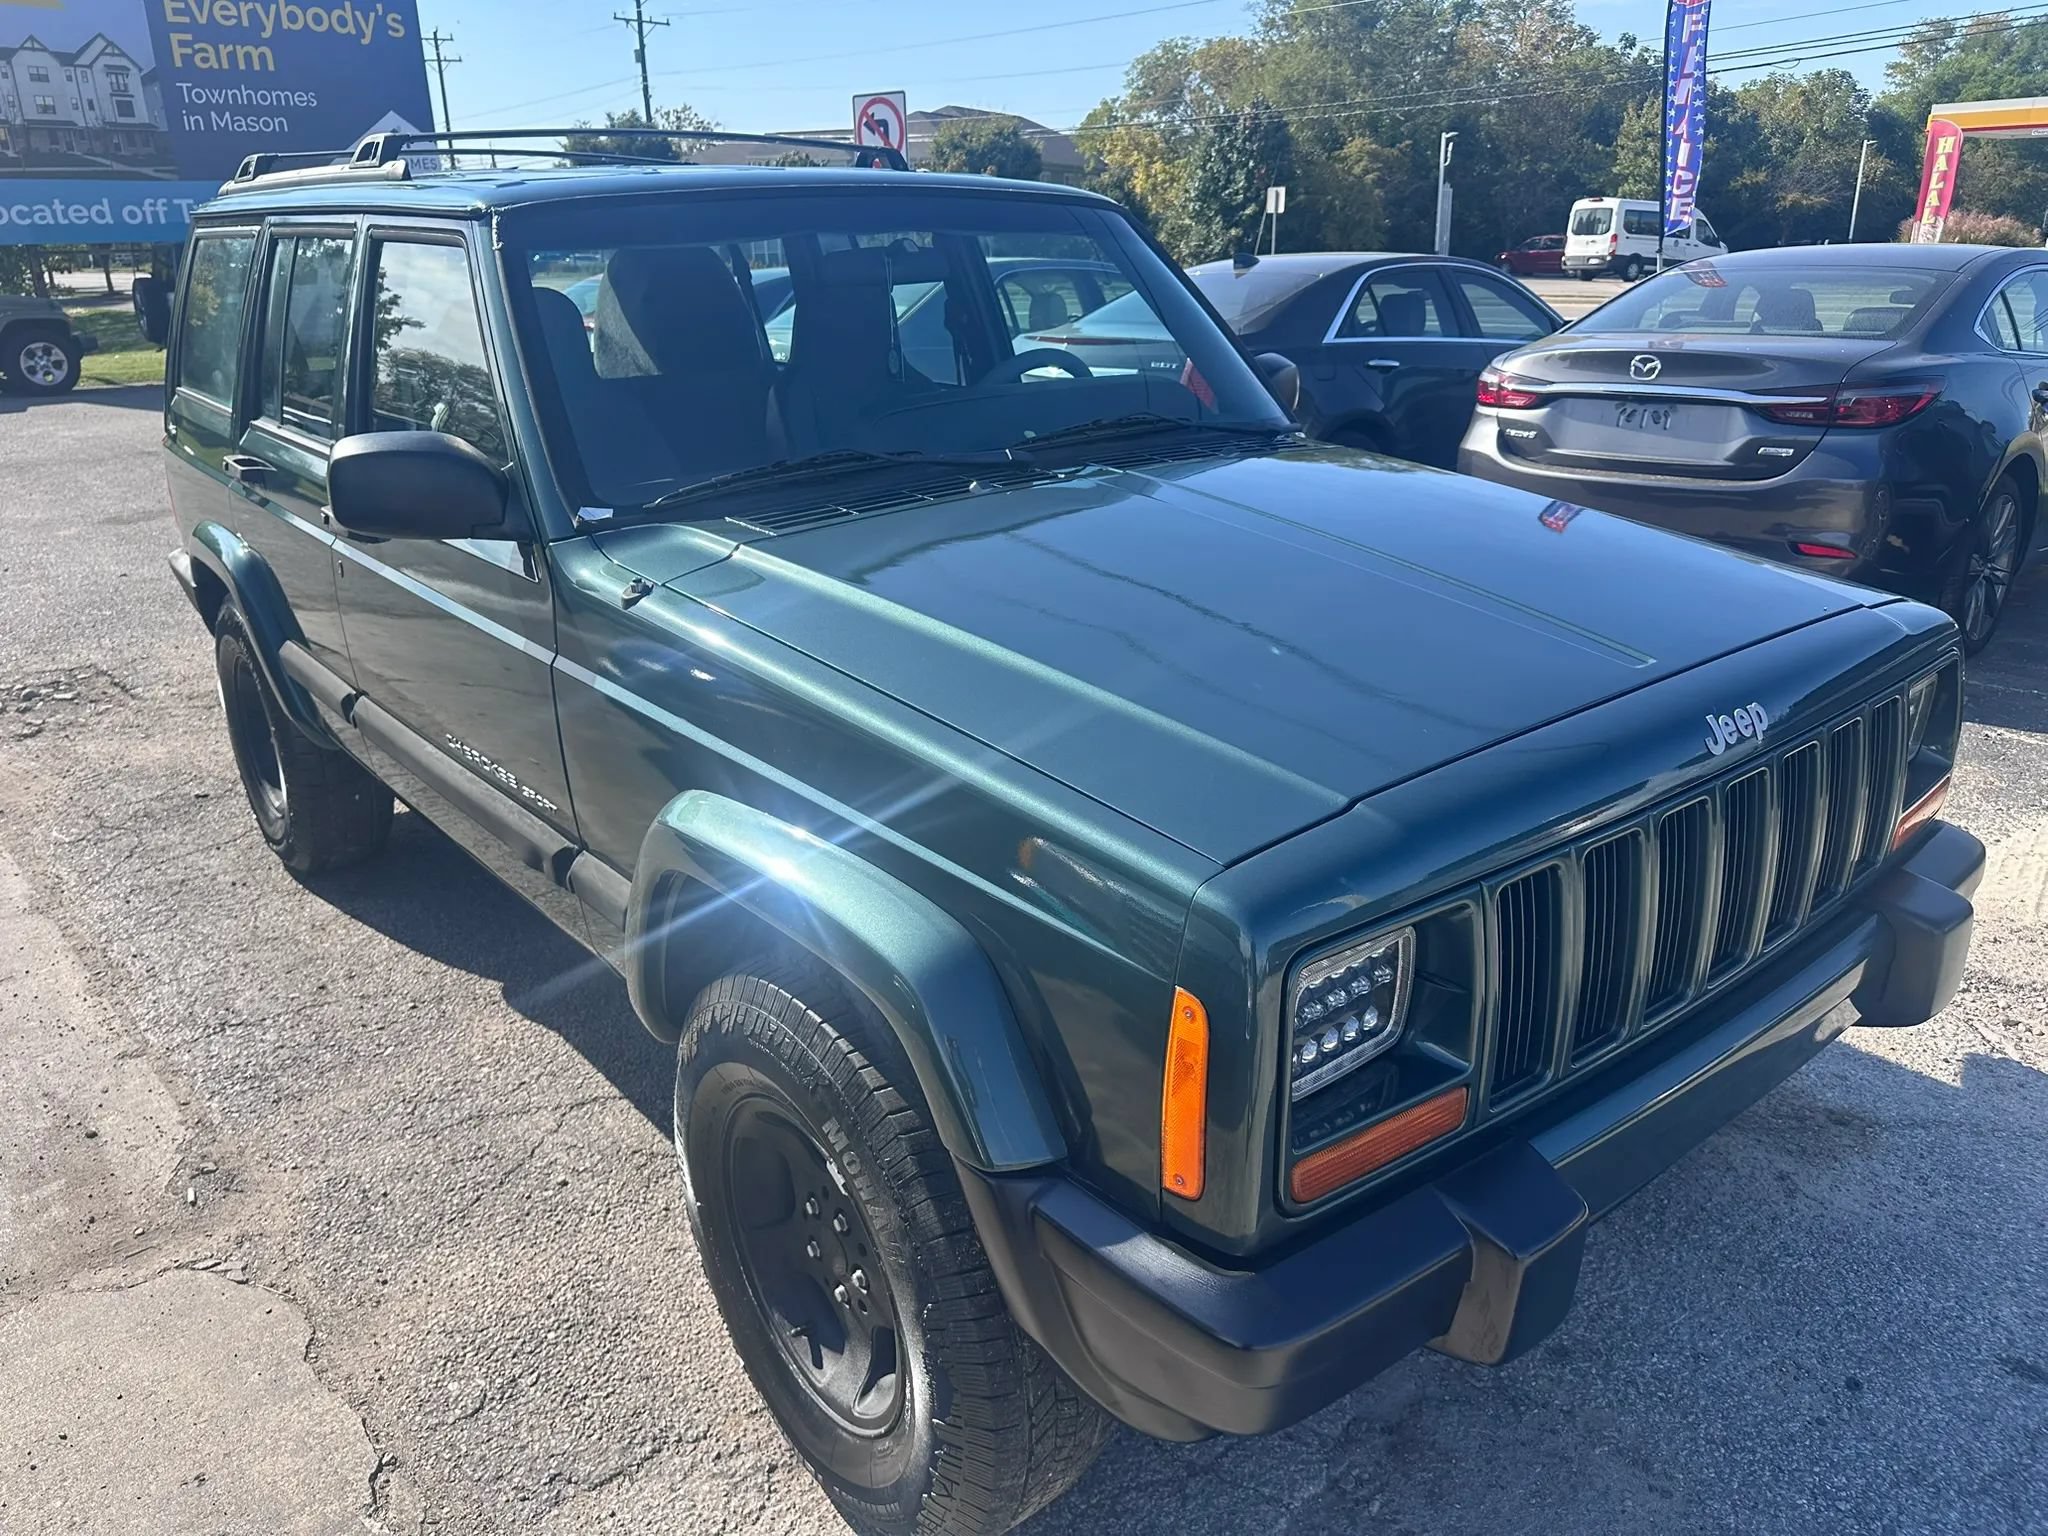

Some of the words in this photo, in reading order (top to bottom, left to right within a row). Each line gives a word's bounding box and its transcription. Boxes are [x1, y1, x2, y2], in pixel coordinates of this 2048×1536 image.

[163, 0, 405, 45] Everybody's
[169, 33, 275, 72] Farm
[175, 82, 317, 107] Townhomes
[182, 109, 205, 131] in
[210, 111, 289, 132] Mason
[1921, 136, 1956, 225] HALAL
[122, 198, 168, 225] off
[1705, 702, 1769, 756] Jeep
